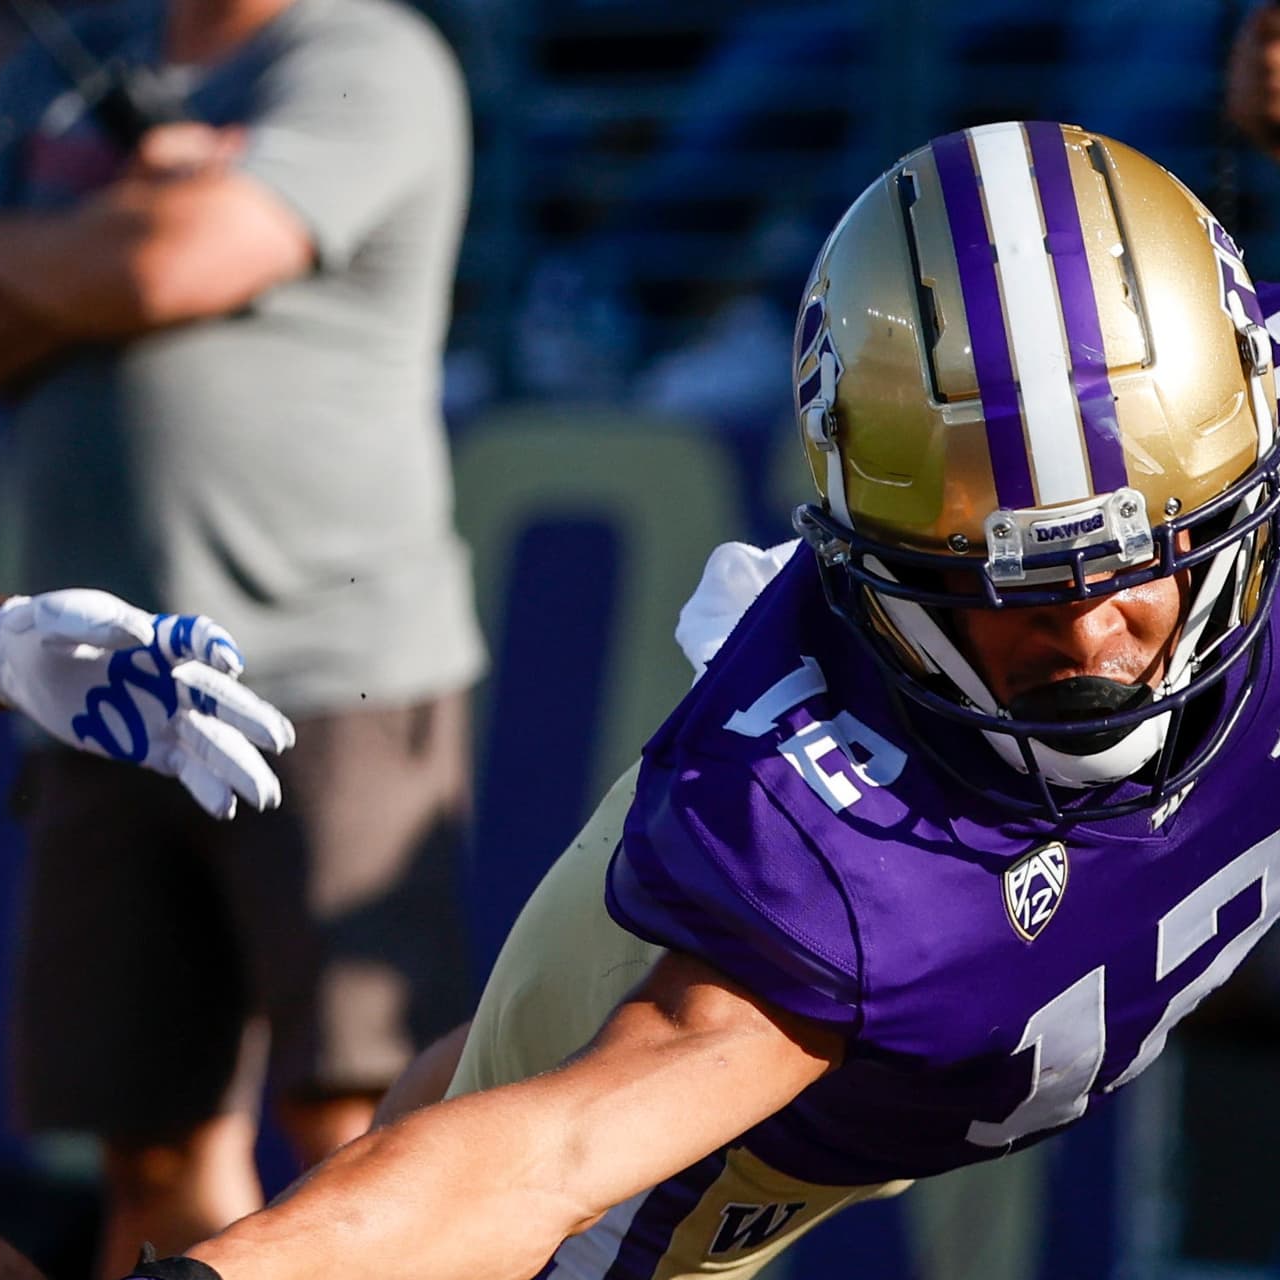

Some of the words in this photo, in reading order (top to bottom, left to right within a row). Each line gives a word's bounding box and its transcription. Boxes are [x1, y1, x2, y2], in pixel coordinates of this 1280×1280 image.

[1034, 512, 1105, 543] DAWGS
[1008, 846, 1065, 919] PAC
[1023, 887, 1054, 931] 12
[708, 1201, 807, 1256] W
